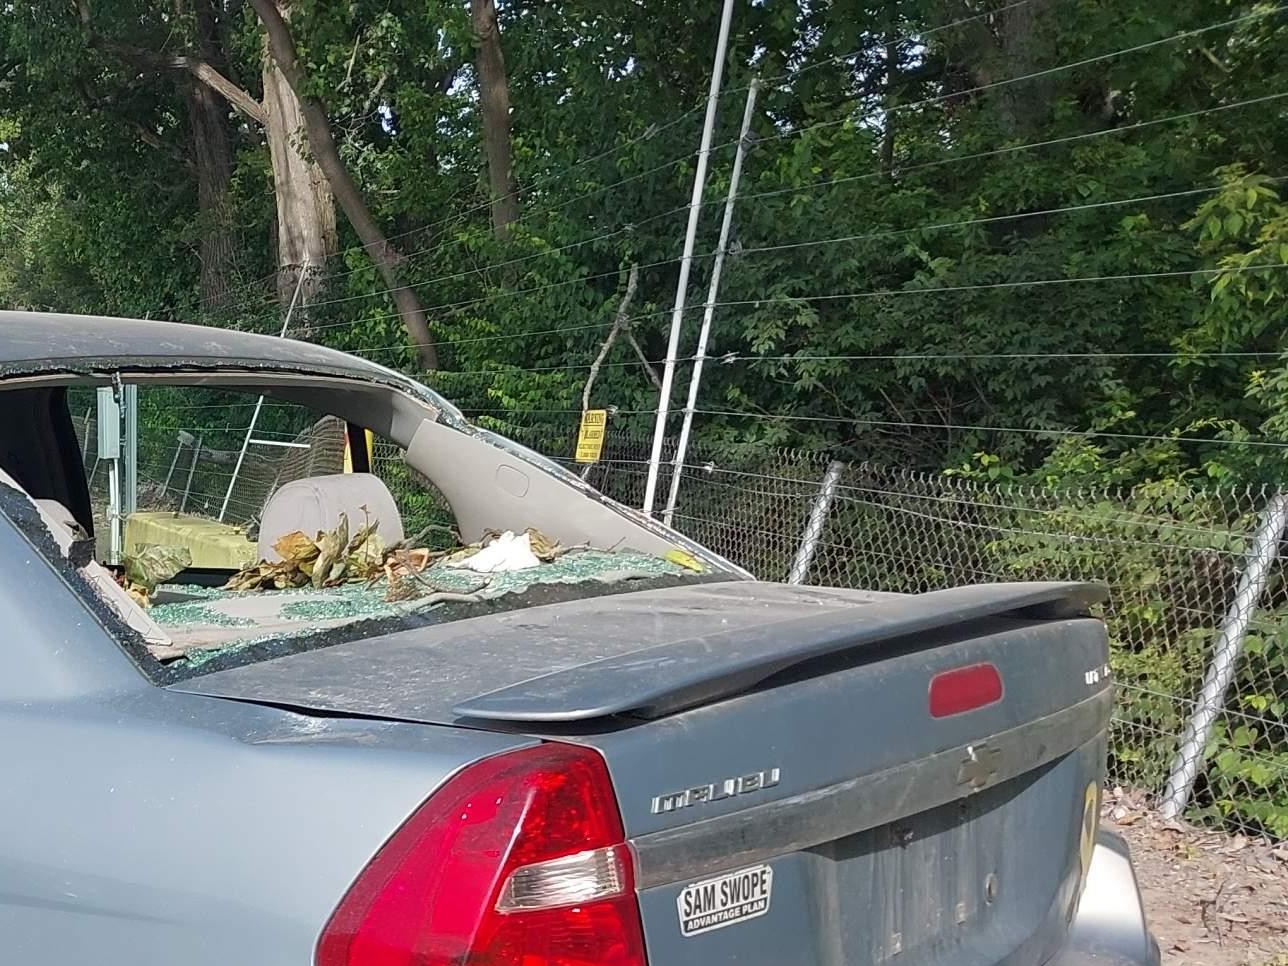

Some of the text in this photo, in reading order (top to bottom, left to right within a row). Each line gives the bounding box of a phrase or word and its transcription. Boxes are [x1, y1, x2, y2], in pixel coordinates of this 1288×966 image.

[650, 767, 780, 814] MALIBU
[684, 869, 767, 918] SAM SWOPE
[686, 899, 765, 931] ADVANTAGE PLAN
